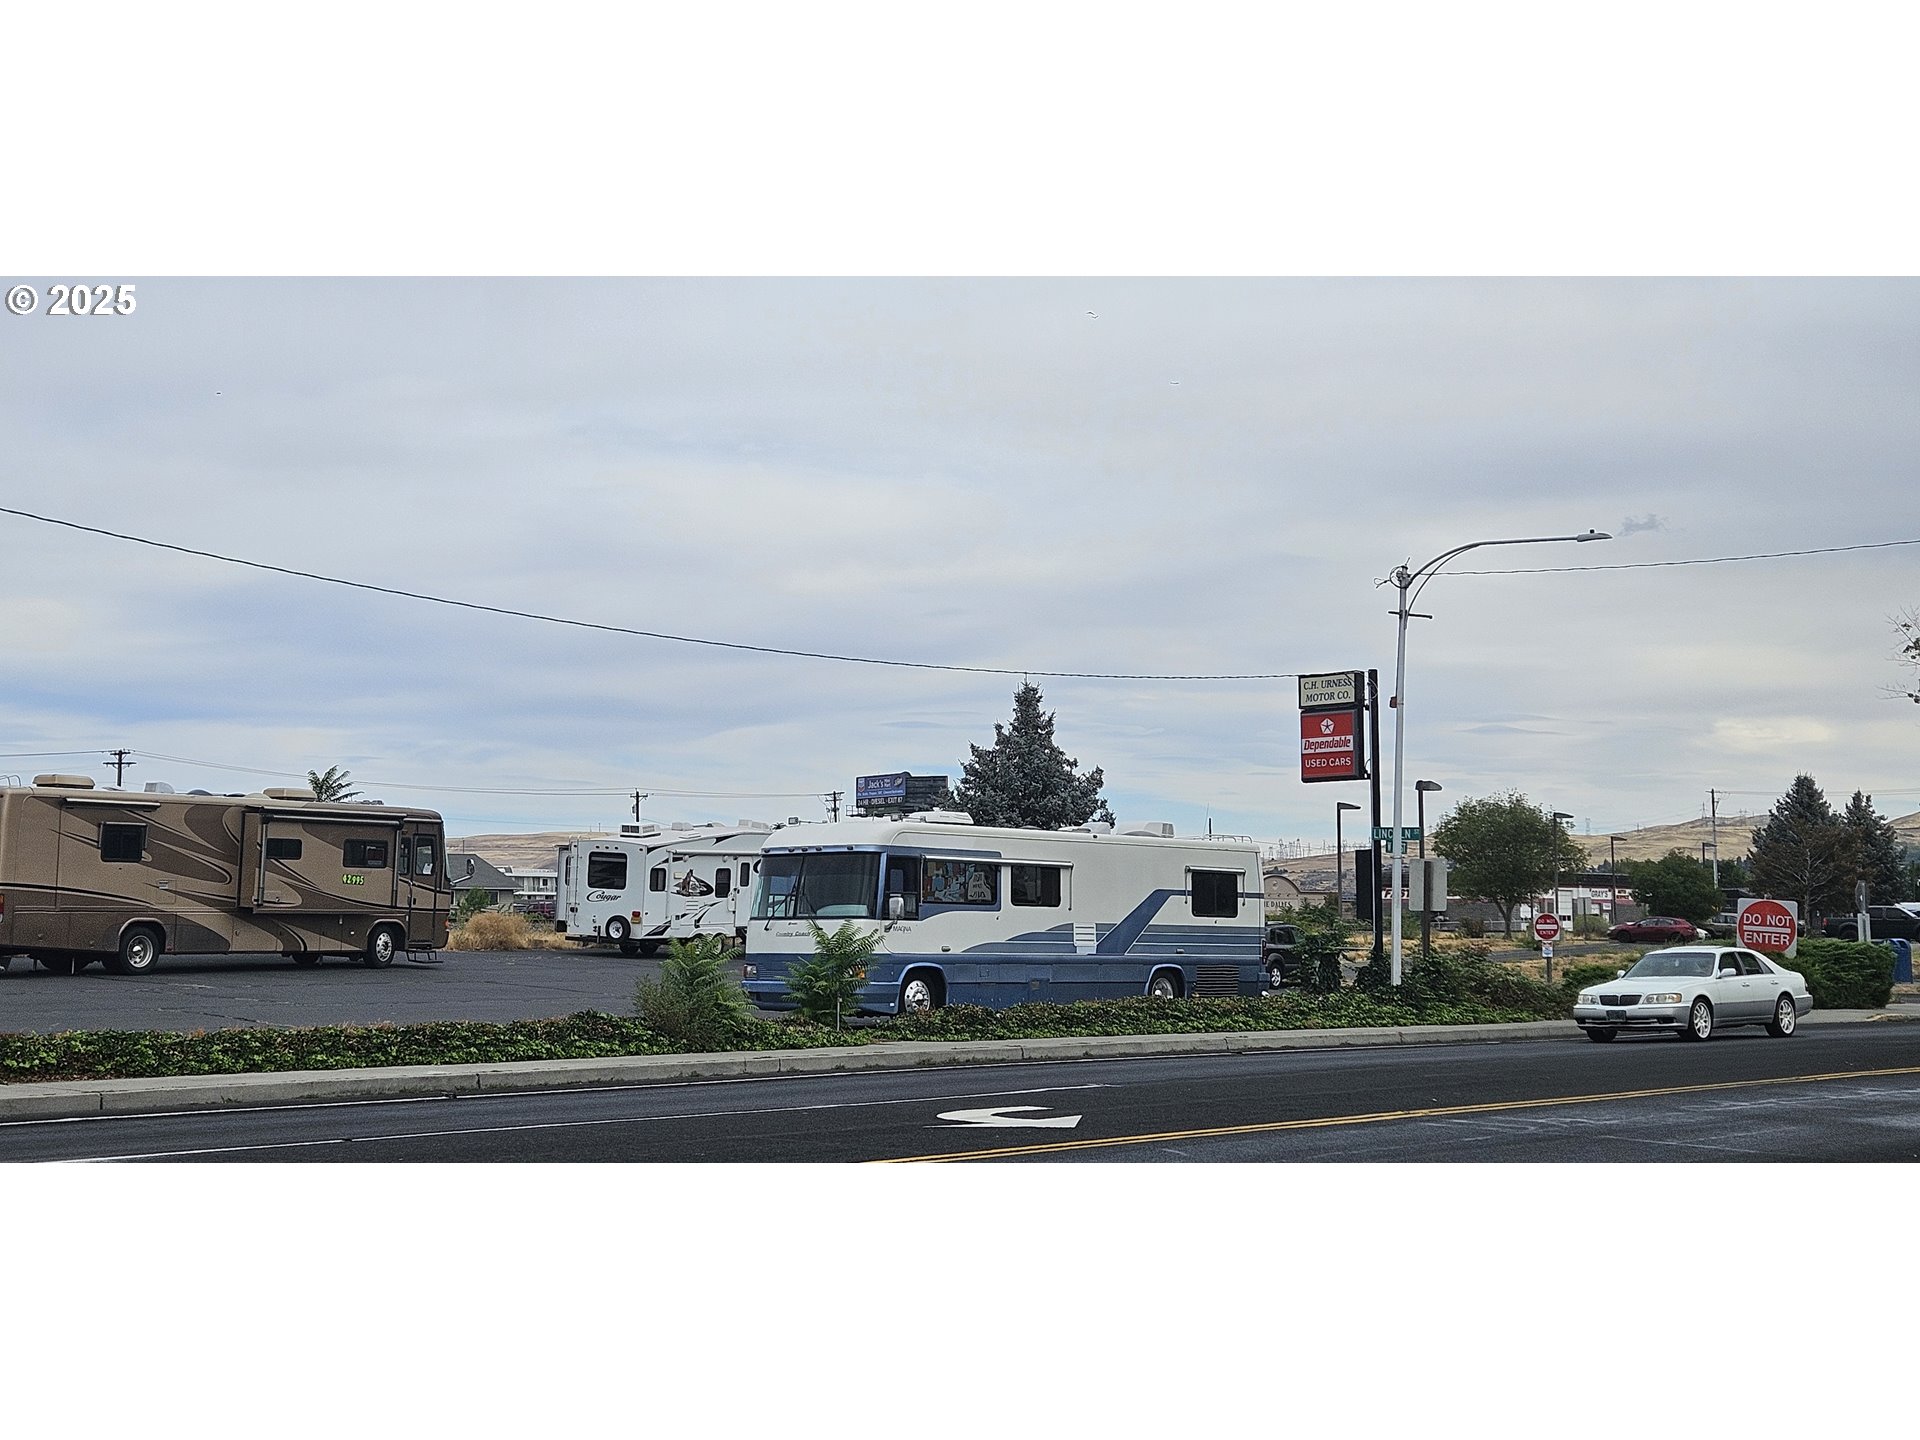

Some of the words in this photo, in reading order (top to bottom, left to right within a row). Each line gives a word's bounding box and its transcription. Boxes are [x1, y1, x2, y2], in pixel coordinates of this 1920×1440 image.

[1303, 681, 1319, 690] C.H.
[1320, 678, 1352, 689] URNESS
[1305, 691, 1335, 702] MOTOR
[1337, 690, 1351, 700] CO.
[1304, 737, 1351, 752] Dependable
[1305, 758, 1327, 768] USED
[1329, 757, 1351, 766] CARS
[868, 778, 884, 789] Jack's
[871, 797, 885, 805] DIESEL
[1373, 829, 1411, 839] LINCN
[586, 890, 621, 902] Cougar
[1744, 914, 1761, 925] DO
[1767, 915, 1792, 926] NOT
[1744, 932, 1789, 945] ENTER
